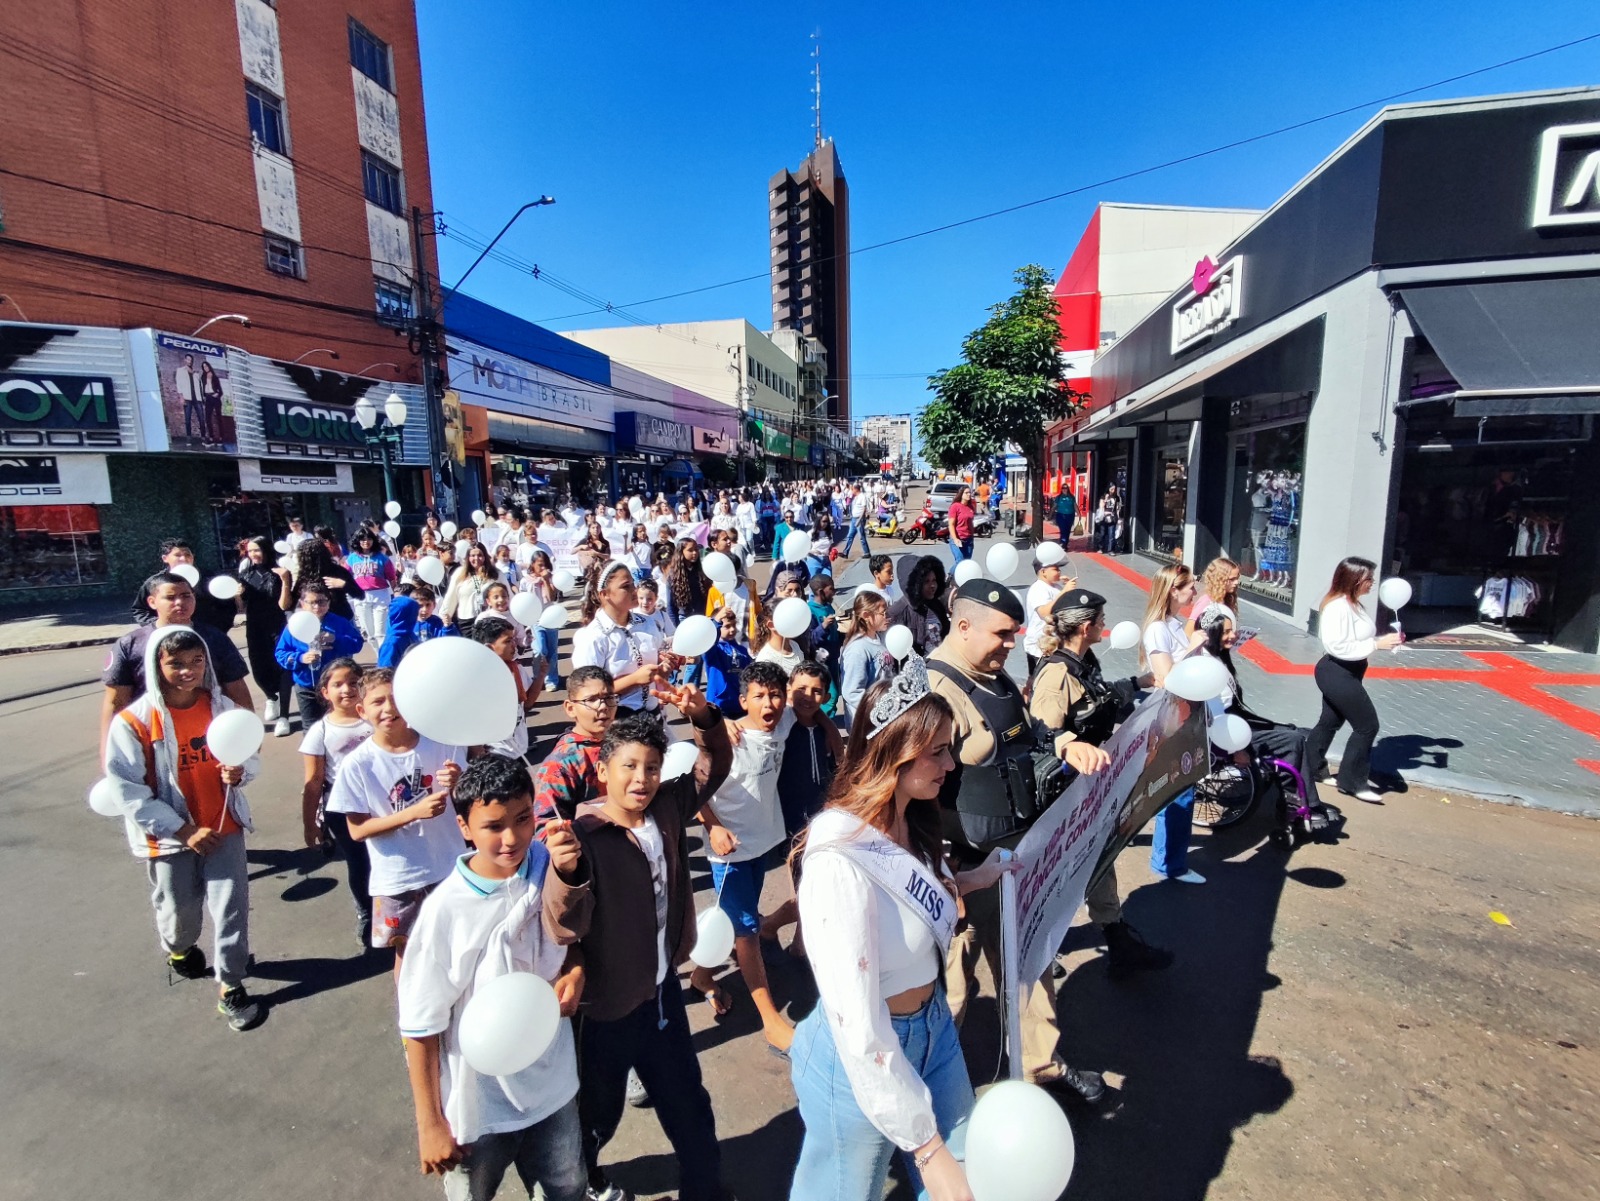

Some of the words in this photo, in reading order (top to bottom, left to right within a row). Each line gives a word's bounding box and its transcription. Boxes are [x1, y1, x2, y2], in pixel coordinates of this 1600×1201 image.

[163, 337, 219, 355] PEGADA
[472, 354, 532, 398] MODA
[541, 383, 592, 412] BRASIL
[273, 403, 392, 443] JORRO
[651, 418, 681, 439] CAMPO
[0, 430, 122, 446] DOS
[656, 435, 677, 448] MODAS
[261, 476, 338, 486] CALÇADOS
[905, 869, 944, 921] MISS
